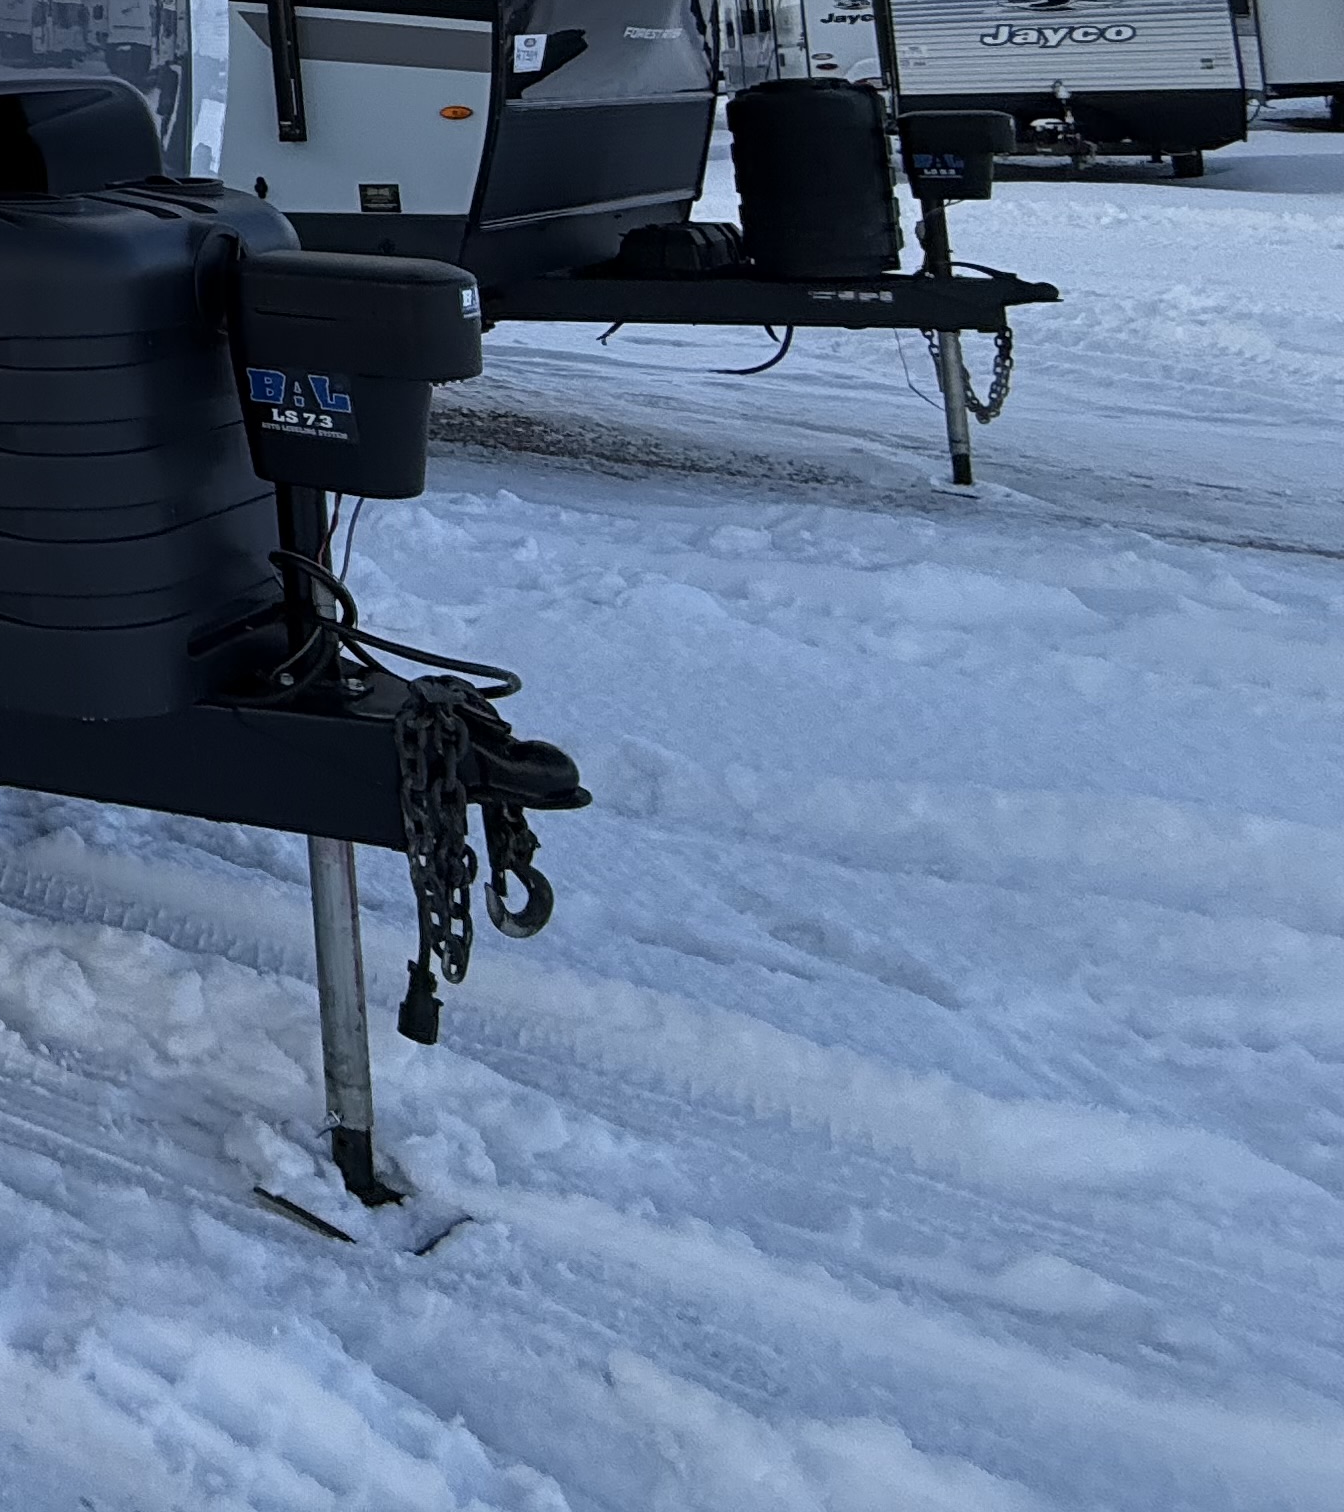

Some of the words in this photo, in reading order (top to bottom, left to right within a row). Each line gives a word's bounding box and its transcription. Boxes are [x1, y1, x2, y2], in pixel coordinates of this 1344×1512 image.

[820, 13, 875, 25] Jayc
[980, 24, 1136, 48] Jayco
[246, 368, 352, 413] BAL
[271, 408, 299, 424] LS
